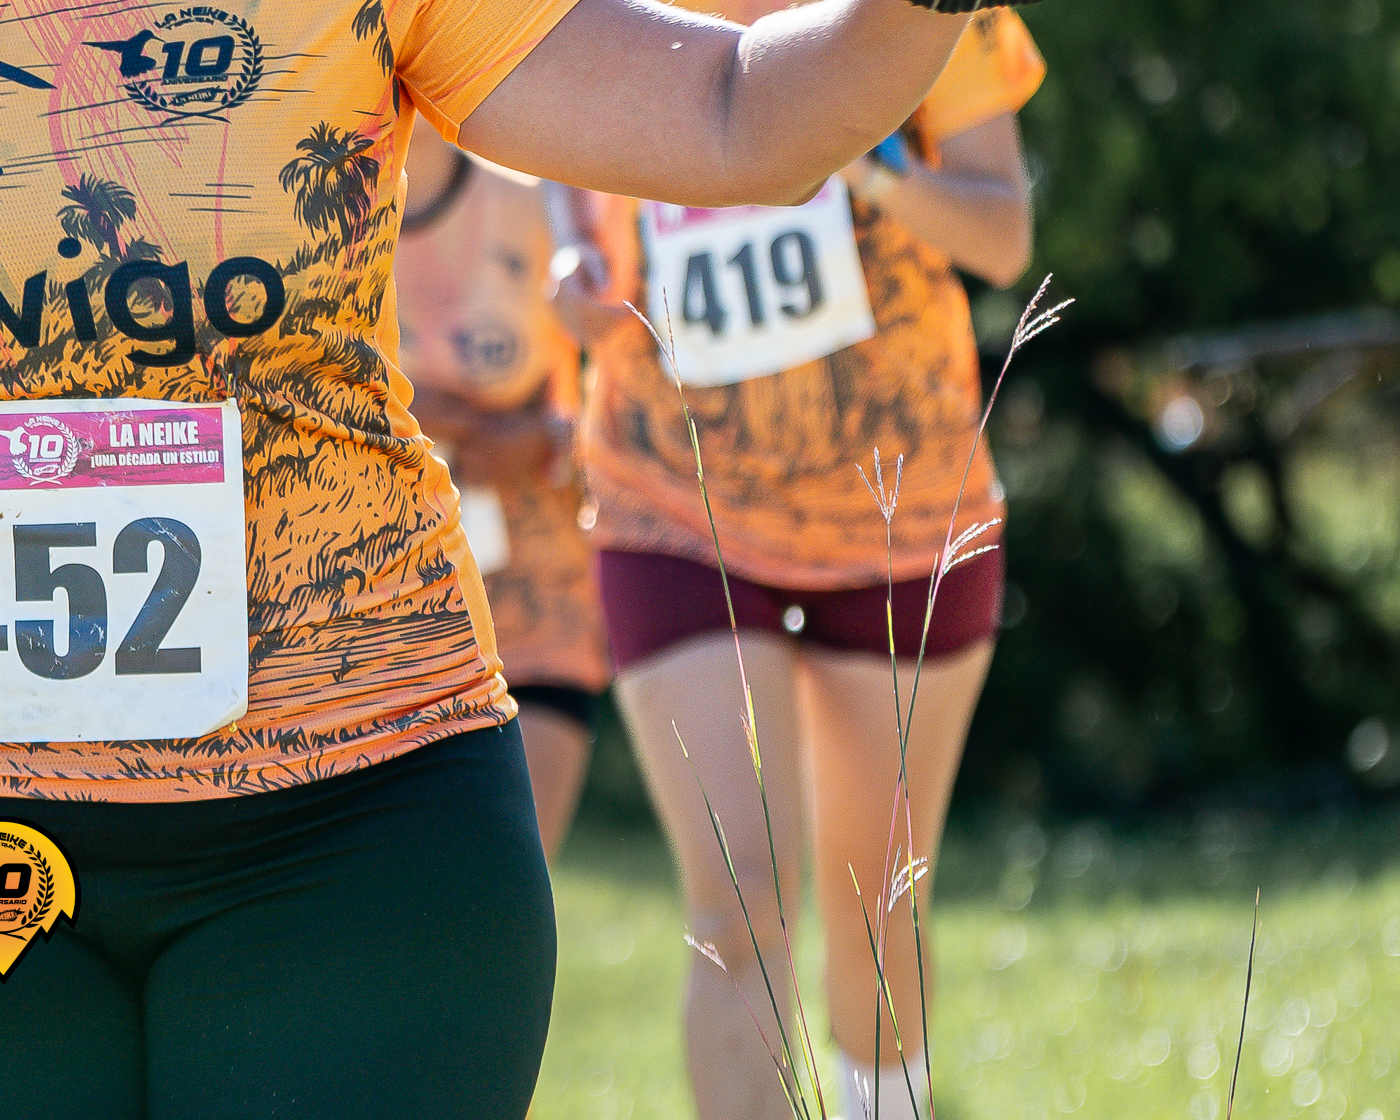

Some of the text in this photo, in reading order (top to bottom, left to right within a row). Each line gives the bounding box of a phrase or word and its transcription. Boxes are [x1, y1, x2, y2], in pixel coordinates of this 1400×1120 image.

[154, 12, 177, 29] LA
[162, 35, 236, 82] 10
[681, 230, 826, 336] 419
[29, 434, 64, 459] 10
[109, 421, 200, 447] LA NEIKE
[90, 454, 117, 468] ¡UNA
[118, 450, 162, 467] DÉCADA
[162, 451, 178, 465] UN
